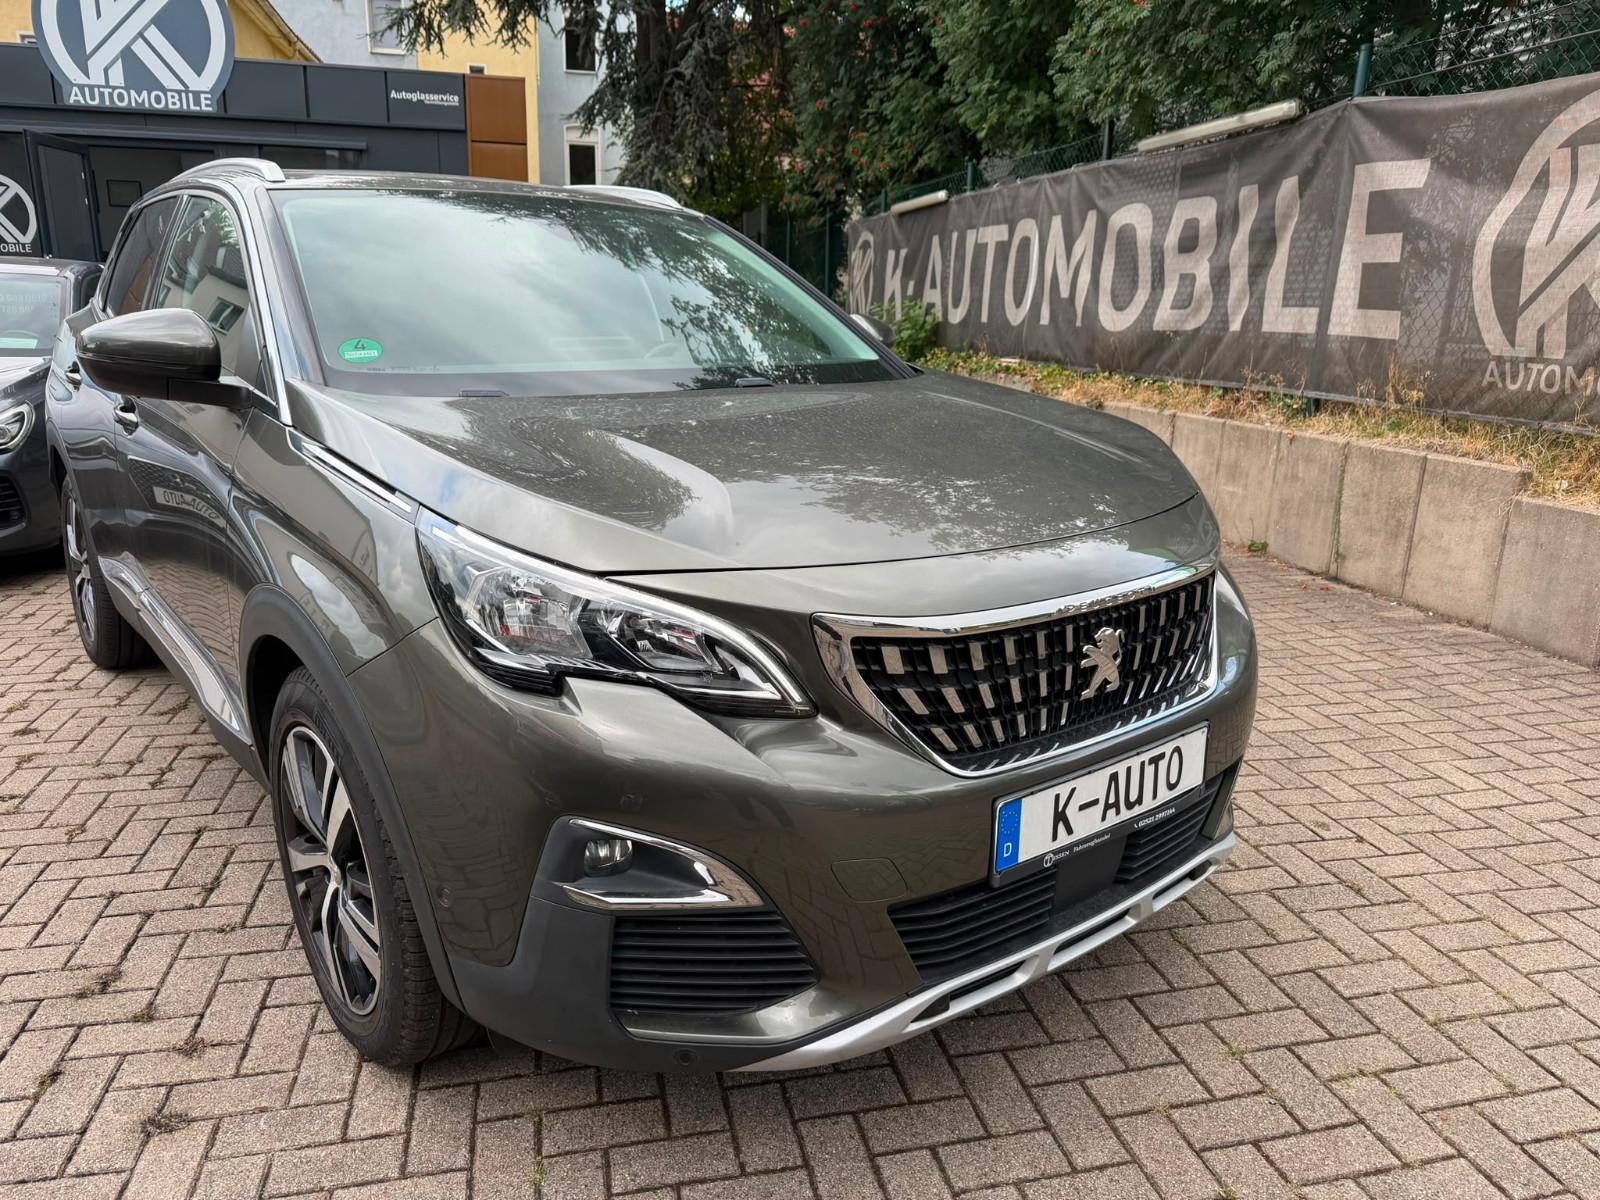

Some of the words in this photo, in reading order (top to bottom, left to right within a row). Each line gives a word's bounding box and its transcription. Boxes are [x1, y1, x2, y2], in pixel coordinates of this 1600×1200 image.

[69, 86, 213, 111] AUTOMOBILE
[390, 89, 459, 102] Autoglasservice
[883, 159, 1431, 340] K-AUTOMOBILE
[354, 339, 367, 351] 4
[1481, 360, 1600, 397] AUTOM
[1052, 745, 1183, 842] K-AUTO
[1003, 842, 1012, 857] D
